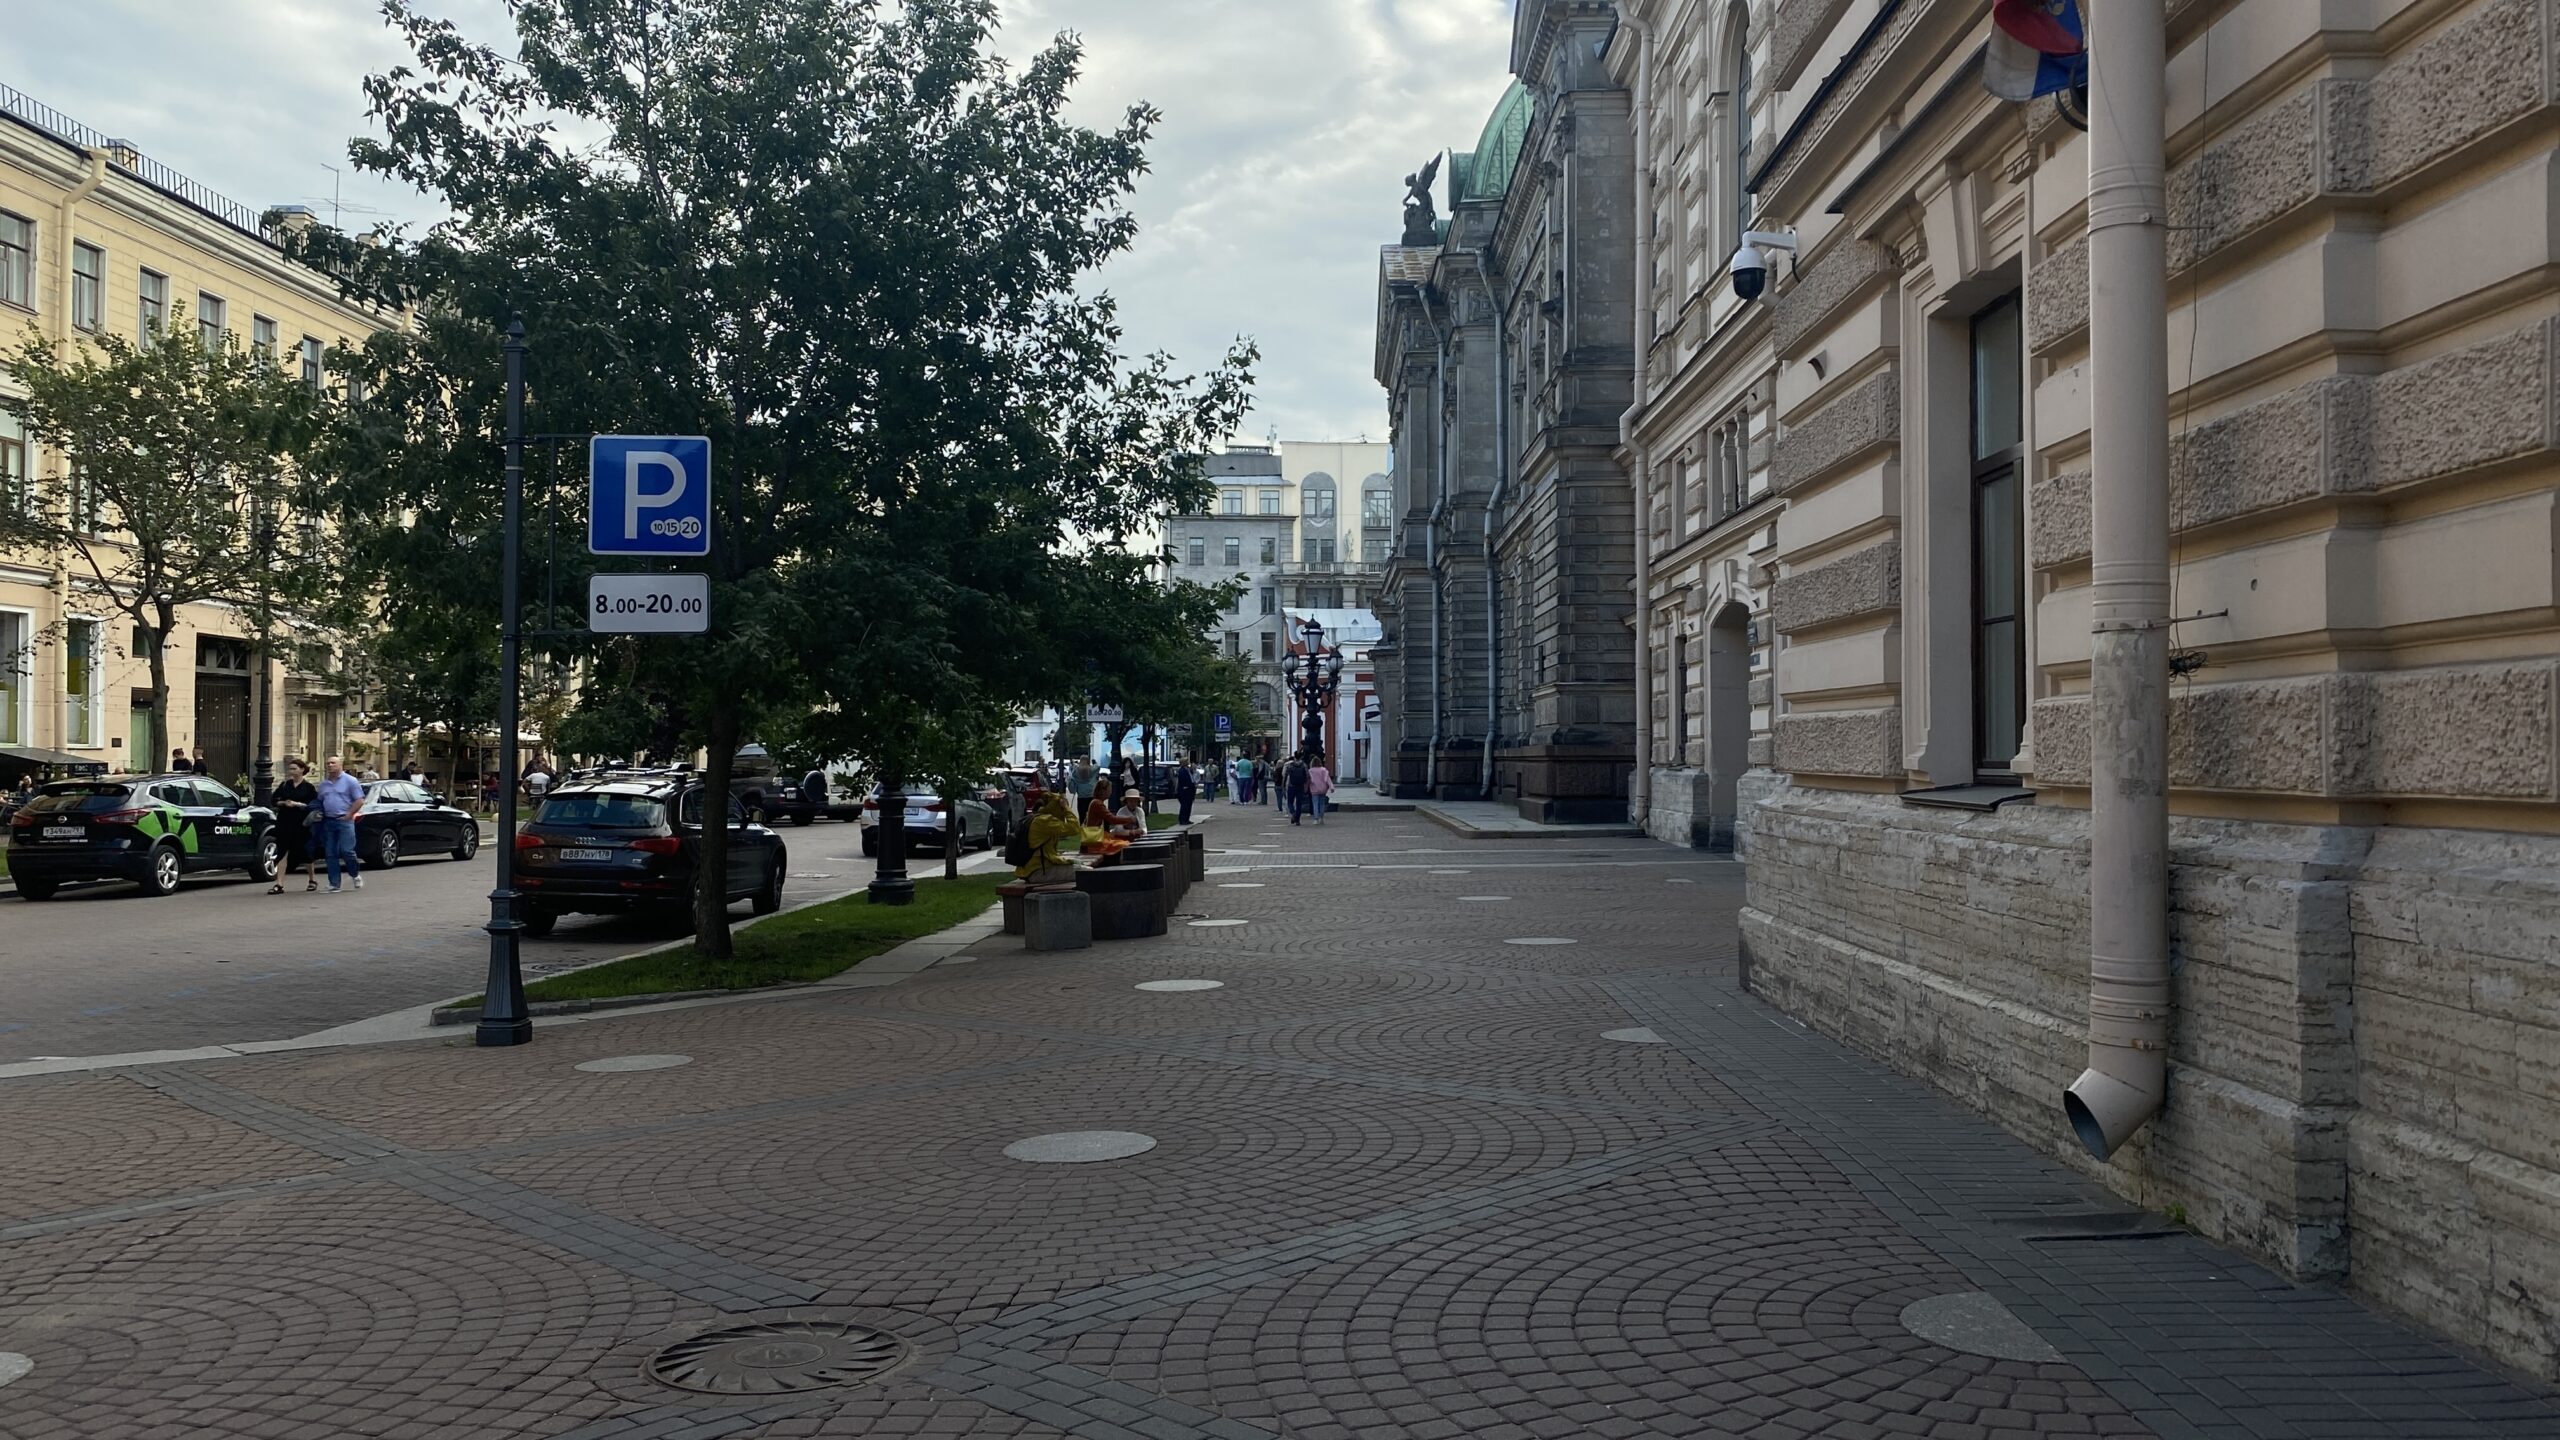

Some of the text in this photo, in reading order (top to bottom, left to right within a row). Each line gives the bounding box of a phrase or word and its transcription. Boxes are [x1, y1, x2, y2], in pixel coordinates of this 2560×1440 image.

[624, 450, 687, 540] P
[653, 521, 700, 534] 10 15 20
[595, 594, 702, 614] 8.00-20.00
[1219, 716, 1228, 729] P
